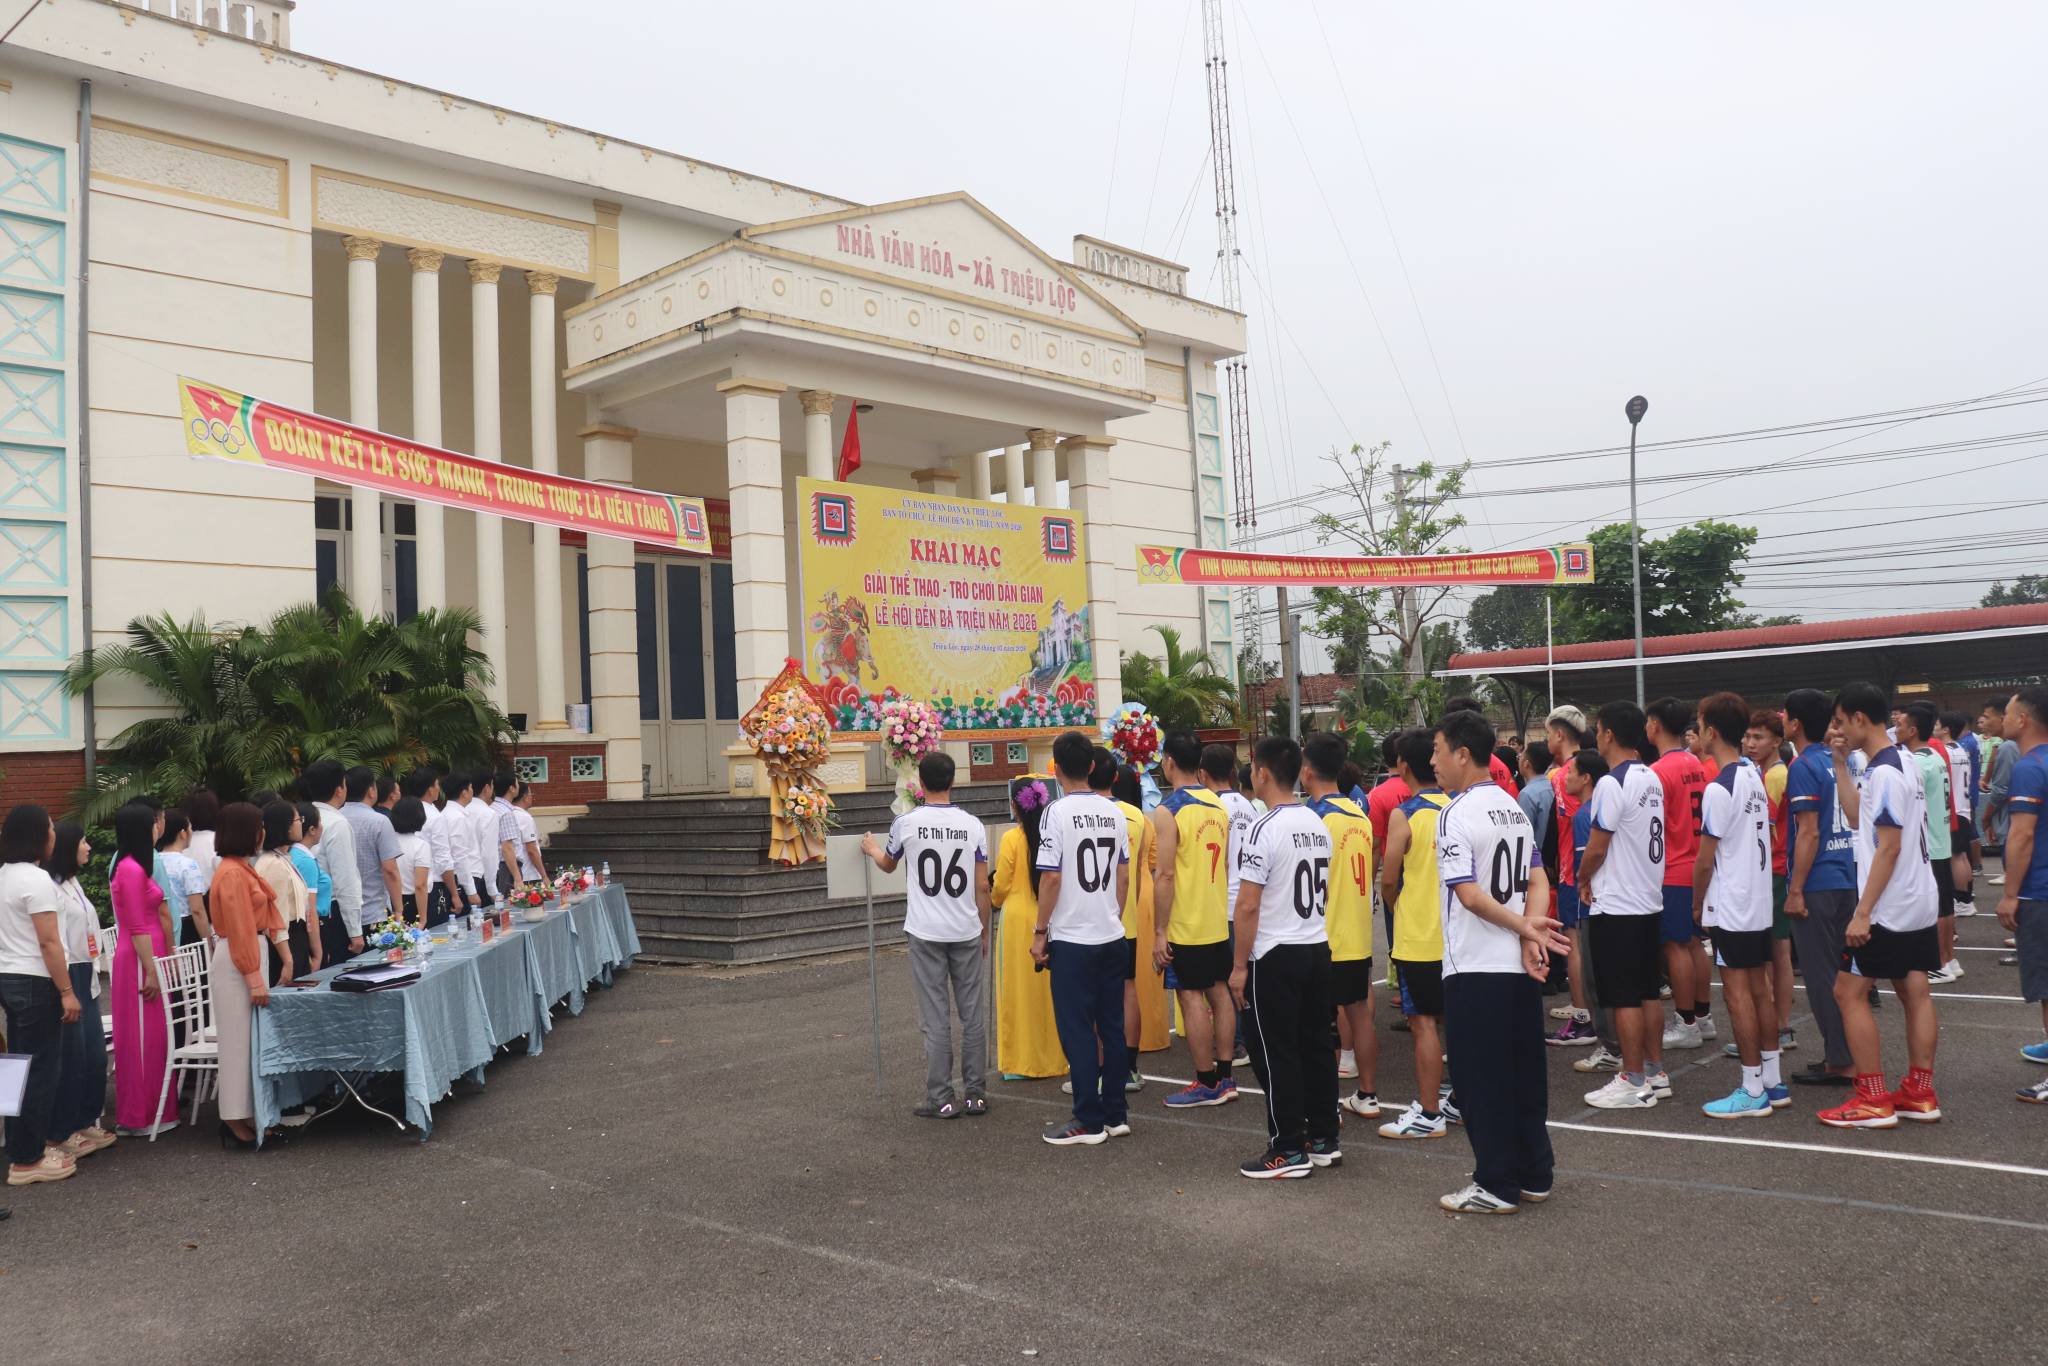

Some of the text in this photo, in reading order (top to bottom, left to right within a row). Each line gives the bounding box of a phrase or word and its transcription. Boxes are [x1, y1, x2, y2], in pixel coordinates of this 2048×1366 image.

[836, 224, 875, 259] NHÀ
[880, 230, 915, 268] VĂN
[920, 241, 953, 278] HÓA
[972, 257, 995, 289] XÃ
[1000, 268, 1045, 305] TRIỆU
[1048, 278, 1077, 314] LỘC
[264, 419, 325, 462] ĐOÀN
[328, 430, 365, 470] KẾT
[369, 440, 394, 477] LÀ
[396, 449, 433, 485] SỨC
[437, 459, 493, 501] MẠNH,
[494, 473, 545, 509] TRUNG
[546, 485, 584, 520] THỰC
[585, 489, 604, 520] LÀ
[605, 494, 634, 526] NỀN
[635, 497, 670, 532] TẢNG
[882, 508, 896, 517] BAN
[910, 539, 1001, 571] KHAI MẠC
[1198, 558, 1219, 576] VINH
[1221, 558, 1250, 578] QUANG
[1252, 555, 1282, 577] KHÔNG
[1283, 556, 1303, 577] PHẢI
[864, 569, 888, 595] GIẢI
[890, 569, 911, 596] THỂ
[913, 577, 940, 598] THAO
[949, 577, 969, 600] TRÒ
[971, 582, 995, 601] CHƠI
[998, 580, 1018, 603] DÂN
[1020, 585, 1044, 604] GIAN
[875, 598, 1038, 633] LỄ HỘI ĐỀN BÀ TRIỆU NĂM 2026
[918, 827, 968, 843] FC Thị Trang
[1072, 814, 1116, 831] FC Thị Trang
[1648, 816, 1664, 864] 8
[1039, 837, 1053, 849] XC
[1292, 833, 1302, 849] FC
[1301, 832, 1312, 852] Thị
[917, 848, 968, 898] 06
[1076, 837, 1116, 893] 07
[1206, 843, 1221, 883] 7
[1350, 852, 1366, 897] 4
[1491, 837, 1529, 904] 04
[1294, 858, 1329, 919] 05
